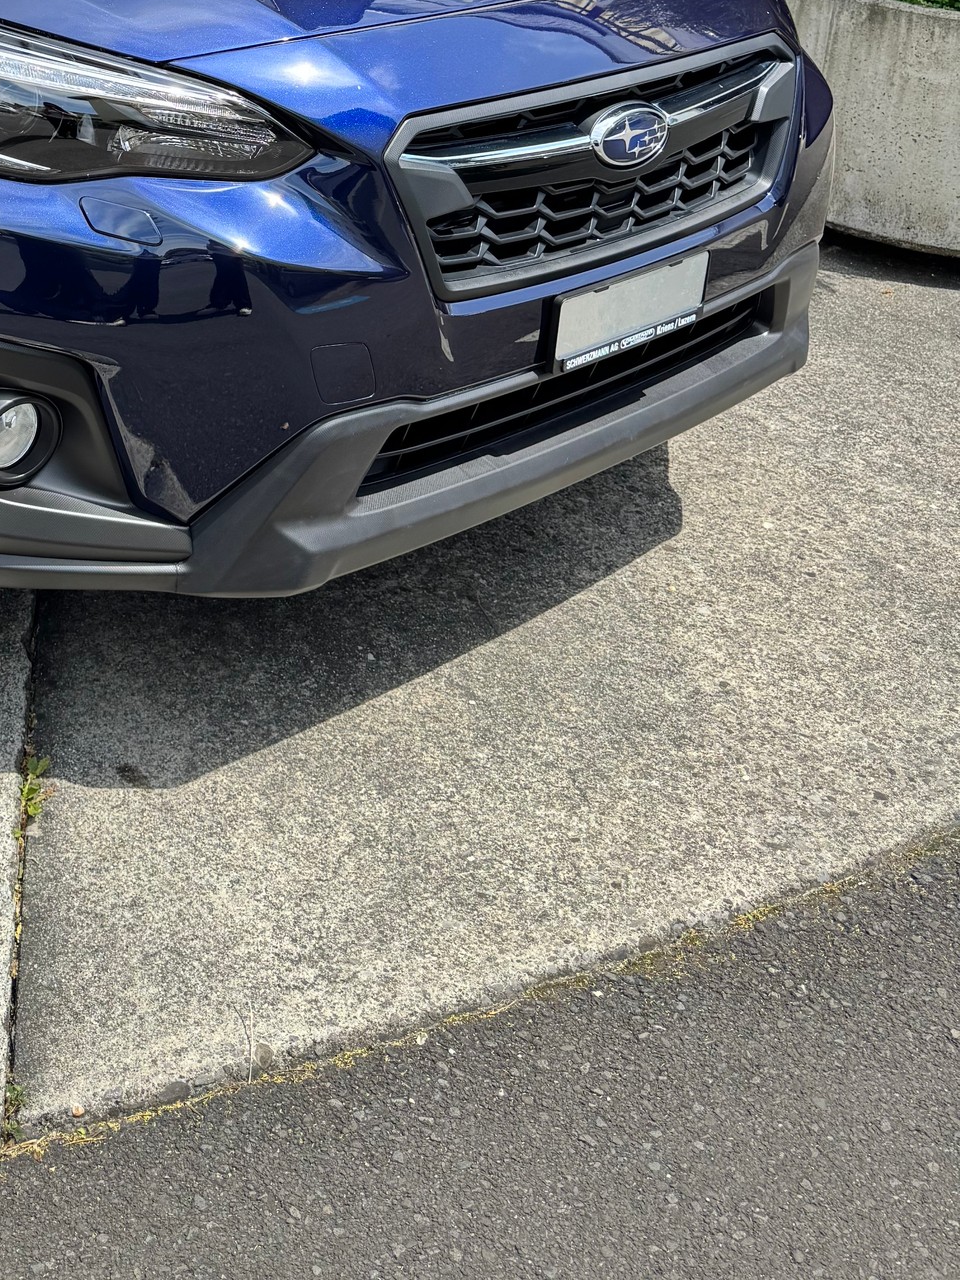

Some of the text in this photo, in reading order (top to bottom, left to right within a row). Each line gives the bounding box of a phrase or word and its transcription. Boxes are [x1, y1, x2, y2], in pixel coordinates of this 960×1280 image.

[566, 345, 609, 370] SCHWERZMANN
[610, 342, 619, 353] AG
[656, 324, 675, 336] Kriens
[678, 314, 696, 327] Luzern
